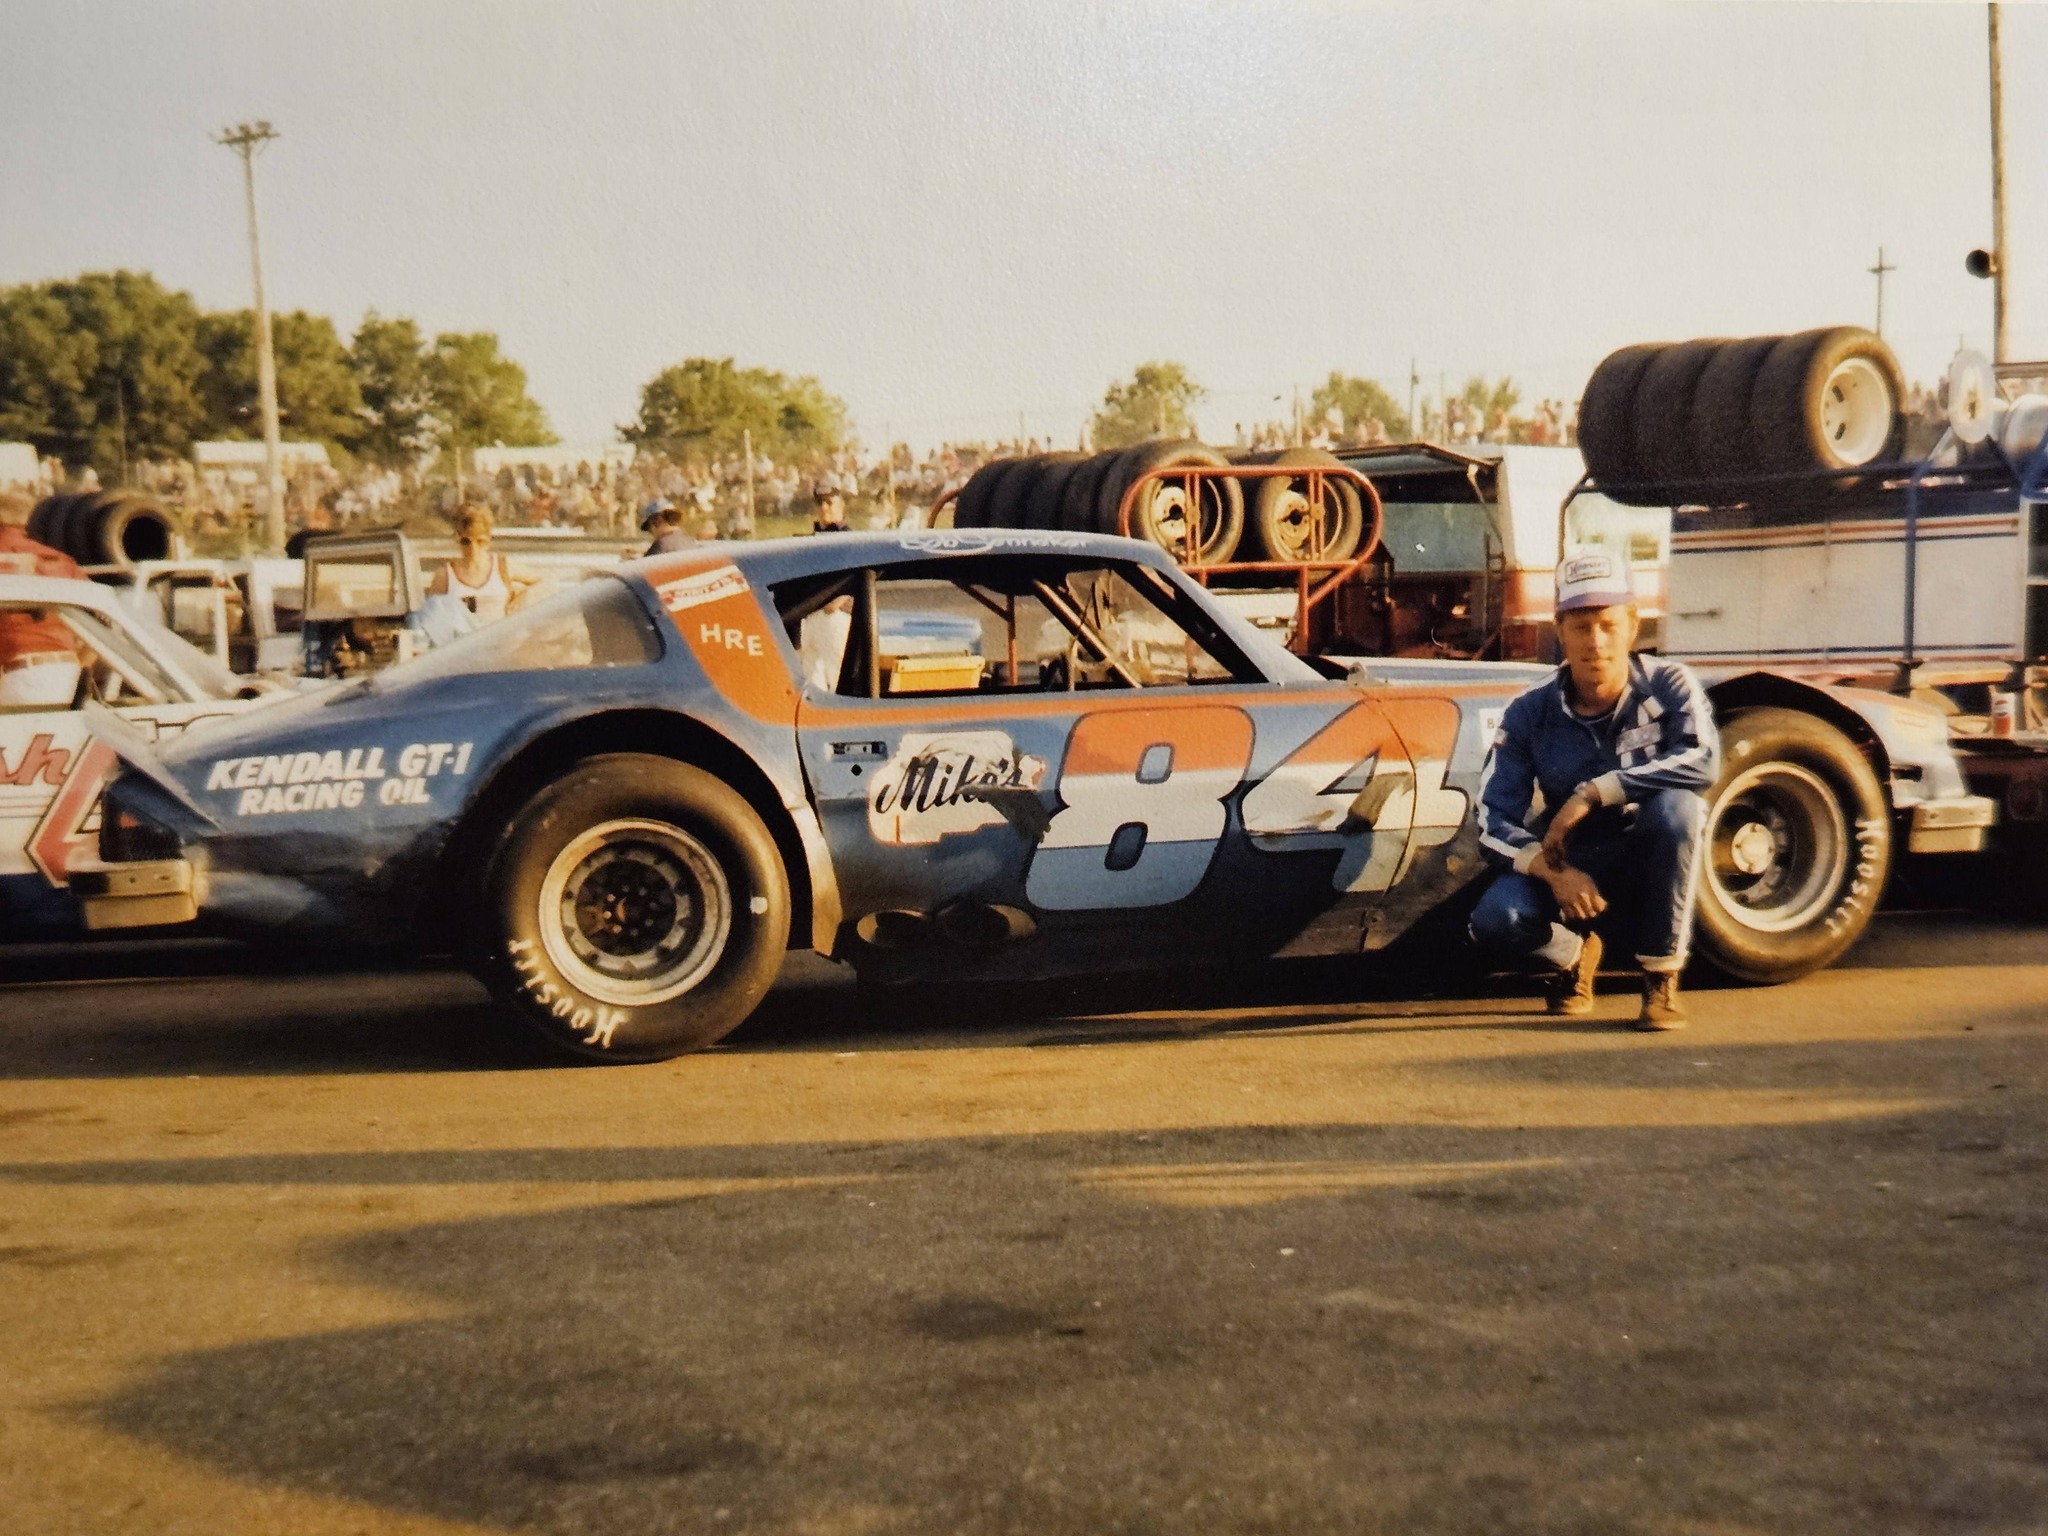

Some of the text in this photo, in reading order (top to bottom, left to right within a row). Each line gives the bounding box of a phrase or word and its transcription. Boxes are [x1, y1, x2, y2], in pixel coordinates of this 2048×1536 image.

[700, 623, 764, 657] HRE
[206, 742, 474, 791] KENDALL GT-1
[237, 777, 431, 816] RACING OIL
[1024, 696, 1469, 911] 84
